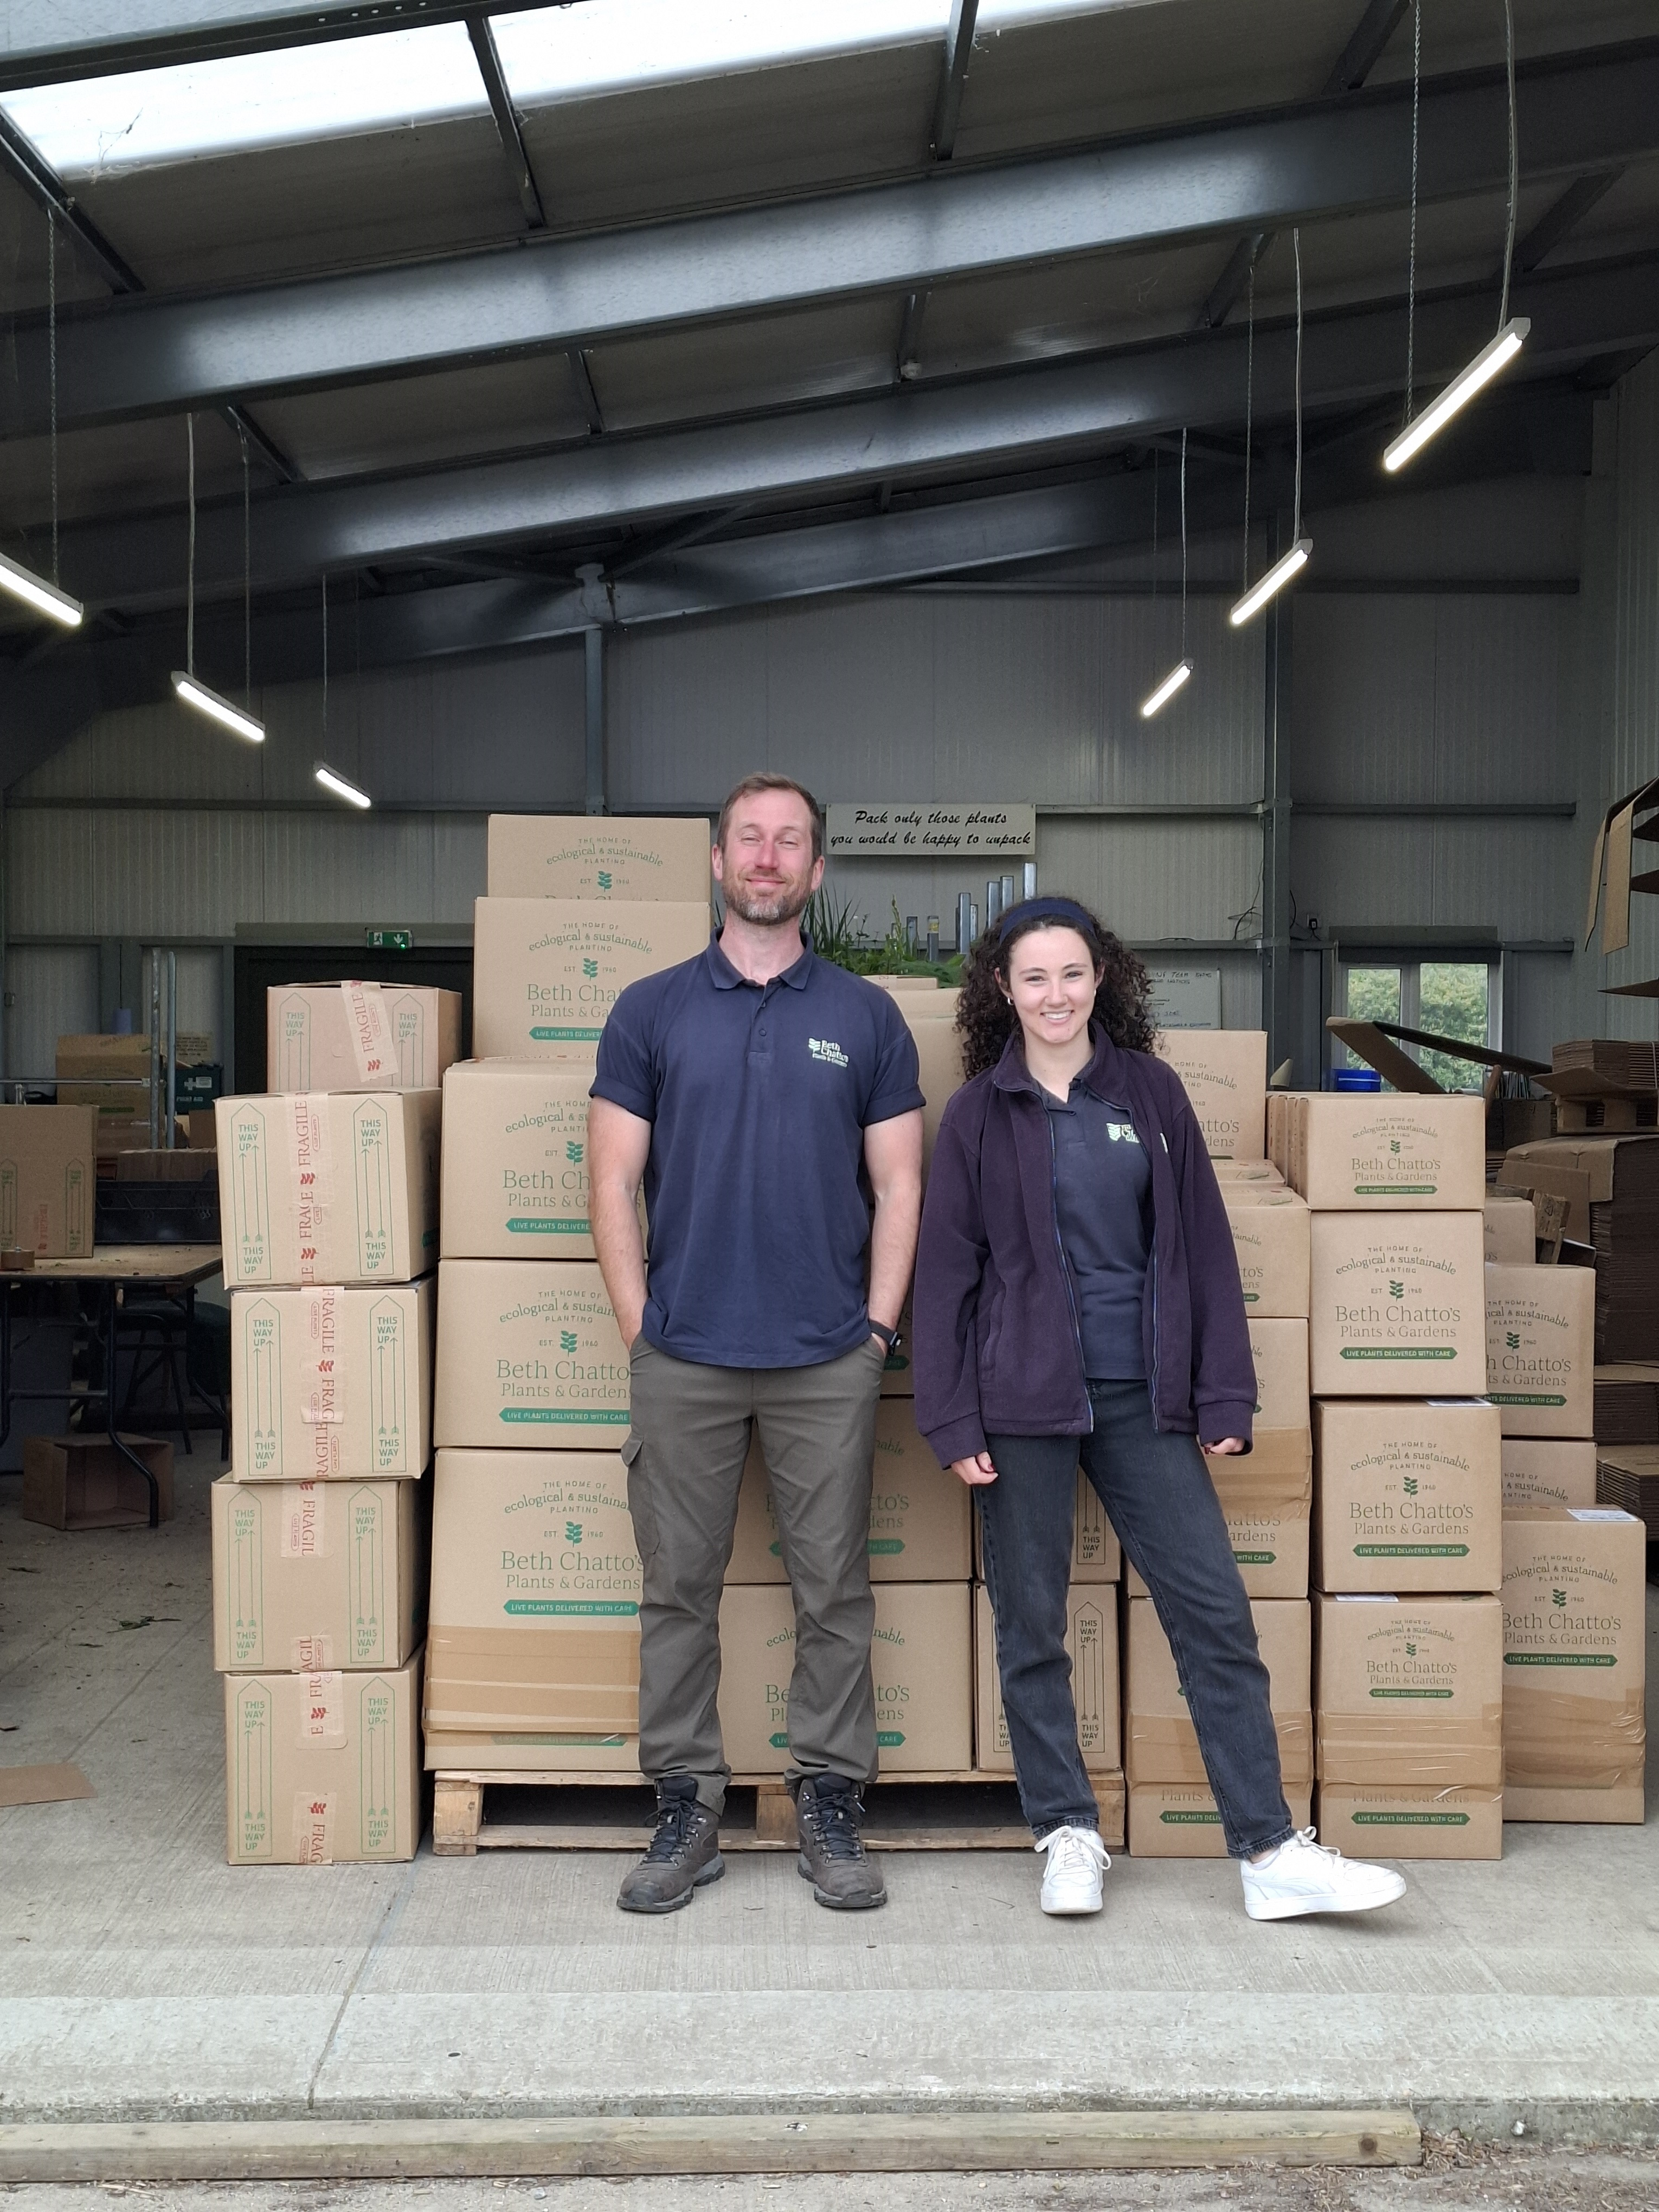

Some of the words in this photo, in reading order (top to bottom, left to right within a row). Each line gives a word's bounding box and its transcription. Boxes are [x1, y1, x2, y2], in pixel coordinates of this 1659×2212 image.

[855, 811, 888, 824] Pack
[895, 812, 921, 826] only
[928, 811, 960, 824] those
[965, 811, 1007, 826] plants
[831, 834, 852, 846] you
[859, 832, 897, 844] would
[904, 832, 916, 844] be
[922, 832, 961, 847] happy
[967, 833, 979, 844] to
[986, 832, 1030, 847] unpack
[546, 844, 595, 865] ecological
[608, 847, 663, 866] sustainable
[529, 929, 581, 951] ecological
[594, 933, 653, 954] sustainable
[528, 984, 571, 1001] Beth
[531, 1005, 574, 1018] Plants
[579, 1006, 588, 1017] &
[351, 993, 375, 1053] FRAGILE
[1185, 1071, 1237, 1089] sustainable
[506, 1109, 563, 1133] ecological
[295, 1101, 311, 1166] FRAGILE
[1352, 1158, 1382, 1170] Beth
[1388, 1159, 1441, 1170] Chatto's
[503, 1171, 554, 1188] Beth
[1355, 1173, 1384, 1181] Plants
[1396, 1173, 1437, 1181] Gardens
[508, 1194, 556, 1207] Plants
[562, 1194, 571, 1207] &
[1336, 1253, 1385, 1275] ecological
[1398, 1255, 1456, 1275] sustainable
[500, 1298, 557, 1322] ecological
[1335, 1306, 1380, 1321] Beth
[1386, 1306, 1460, 1321] Chatto's
[1515, 1309, 1569, 1328] sustainable
[322, 1288, 335, 1353] FRAGILE
[1341, 1326, 1382, 1337] Plants
[1387, 1327, 1395, 1337] &
[1399, 1326, 1456, 1337] Gardens
[497, 1360, 548, 1378] Beth
[555, 1361, 629, 1380] Chatto
[1502, 1355, 1571, 1372] Chatto's
[1503, 1375, 1510, 1384] &
[1514, 1375, 1566, 1386] Gardens
[501, 1383, 549, 1397] Plants
[555, 1385, 564, 1397] &
[1351, 1449, 1400, 1470] ecological
[1413, 1451, 1469, 1471] sustainable
[1515, 1481, 1568, 1501] sustainable
[504, 1488, 562, 1513] ecological
[1349, 1502, 1393, 1518] Beth
[1400, 1502, 1473, 1518] Chatto's
[302, 1500, 315, 1556] FRAGIL
[1354, 1523, 1396, 1534] Plants
[1401, 1523, 1409, 1534] &
[1412, 1522, 1469, 1534] Gardens
[501, 1551, 552, 1570] Beth
[560, 1552, 644, 1571] Chatto's
[506, 1575, 554, 1588] Plants
[560, 1576, 570, 1588] &
[574, 1576, 640, 1590] Gardens
[1561, 1564, 1618, 1584] sustainable
[1503, 1613, 1542, 1629] Beth
[1548, 1614, 1621, 1630] Chatto's
[1504, 1632, 1544, 1644] Plants
[1549, 1633, 1557, 1644] &
[1560, 1633, 1617, 1645] Gardens
[1367, 1661, 1398, 1673] Beth
[1403, 1661, 1457, 1674] Chatto's
[1369, 1675, 1399, 1684] Plants
[1412, 1675, 1453, 1684] Gardens
[1161, 1789, 1203, 1801] Plants
